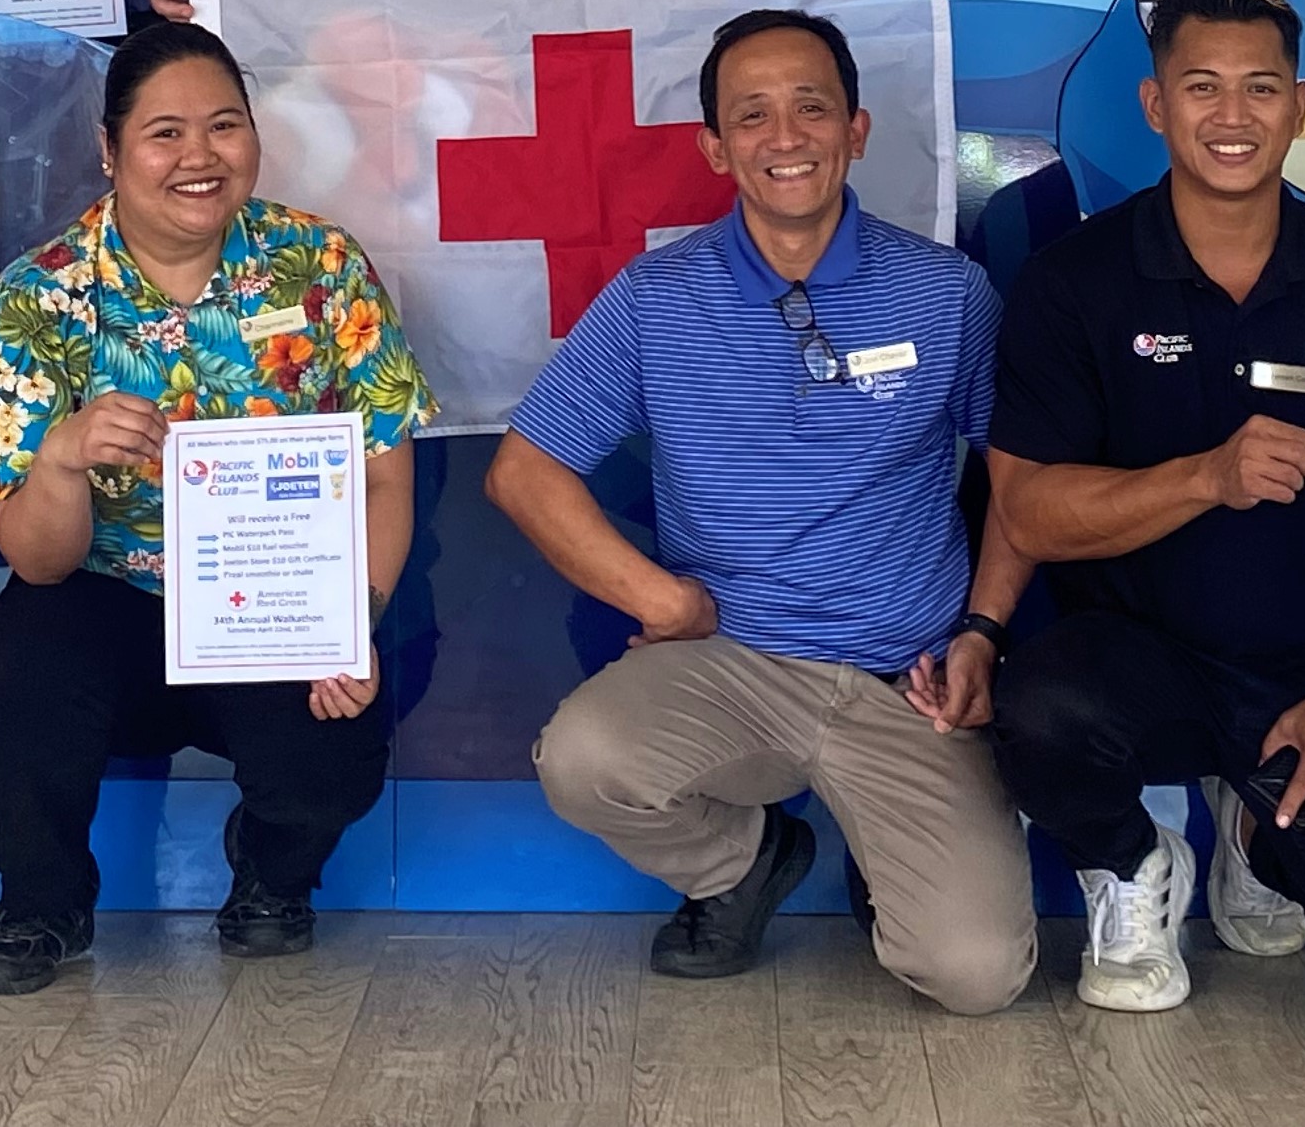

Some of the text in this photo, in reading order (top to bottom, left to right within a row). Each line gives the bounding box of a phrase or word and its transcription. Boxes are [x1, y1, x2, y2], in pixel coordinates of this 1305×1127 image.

[211, 458, 254, 471] PACIFIC
[267, 451, 318, 469] Mobil
[211, 471, 259, 483] ISLANDS
[208, 484, 238, 496] CLUB
[276, 480, 318, 490] JOETEN
